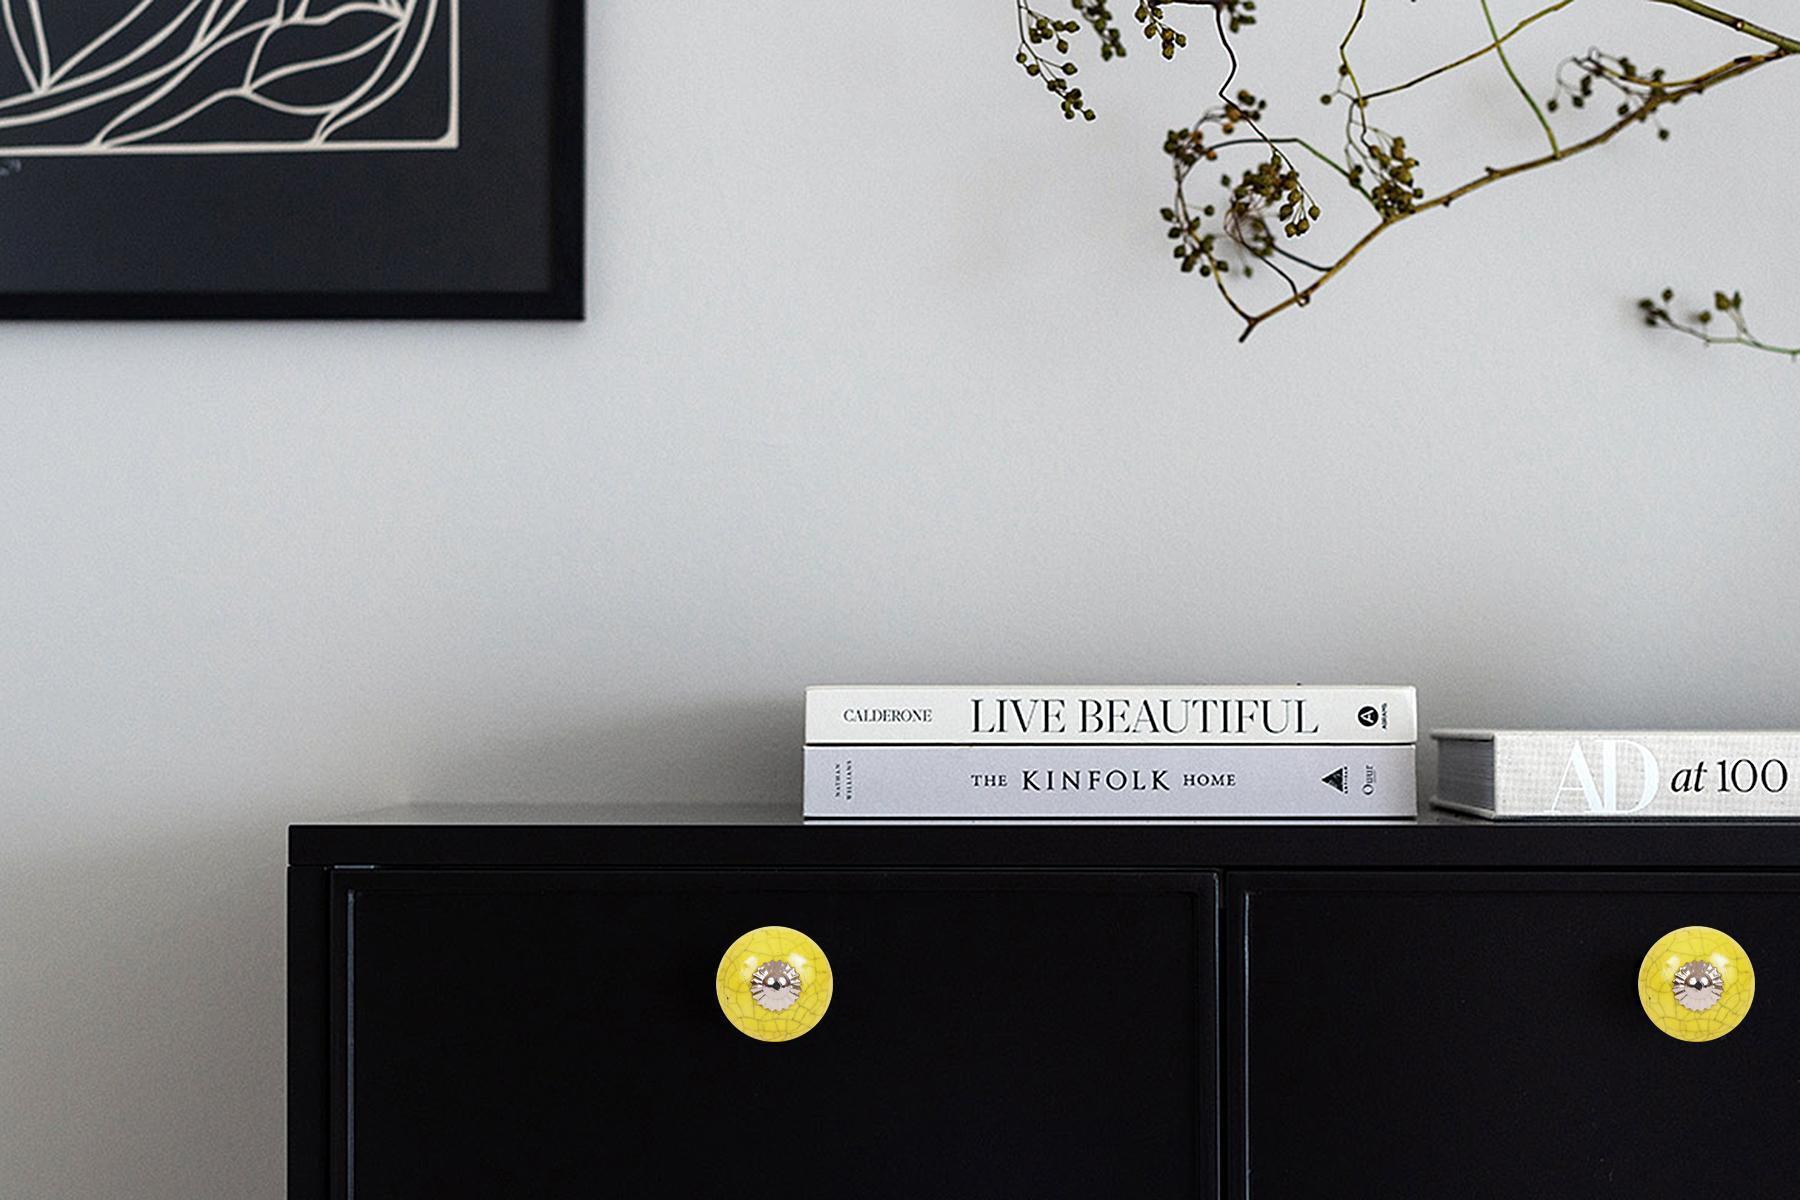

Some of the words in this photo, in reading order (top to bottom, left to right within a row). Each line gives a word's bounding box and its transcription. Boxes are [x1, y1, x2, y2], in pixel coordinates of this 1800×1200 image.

[843, 708, 933, 723] CALDERONE
[970, 698, 1066, 734] LIVE
[1077, 698, 1320, 735] BEAUTIFUL
[1359, 708, 1376, 725] A
[970, 774, 1008, 787] THE
[1021, 769, 1171, 792] KINFOLK
[1183, 773, 1237, 787] HOME
[1544, 738, 1661, 815] AD
[1670, 760, 1709, 793] at
[1716, 758, 1789, 794] 100
